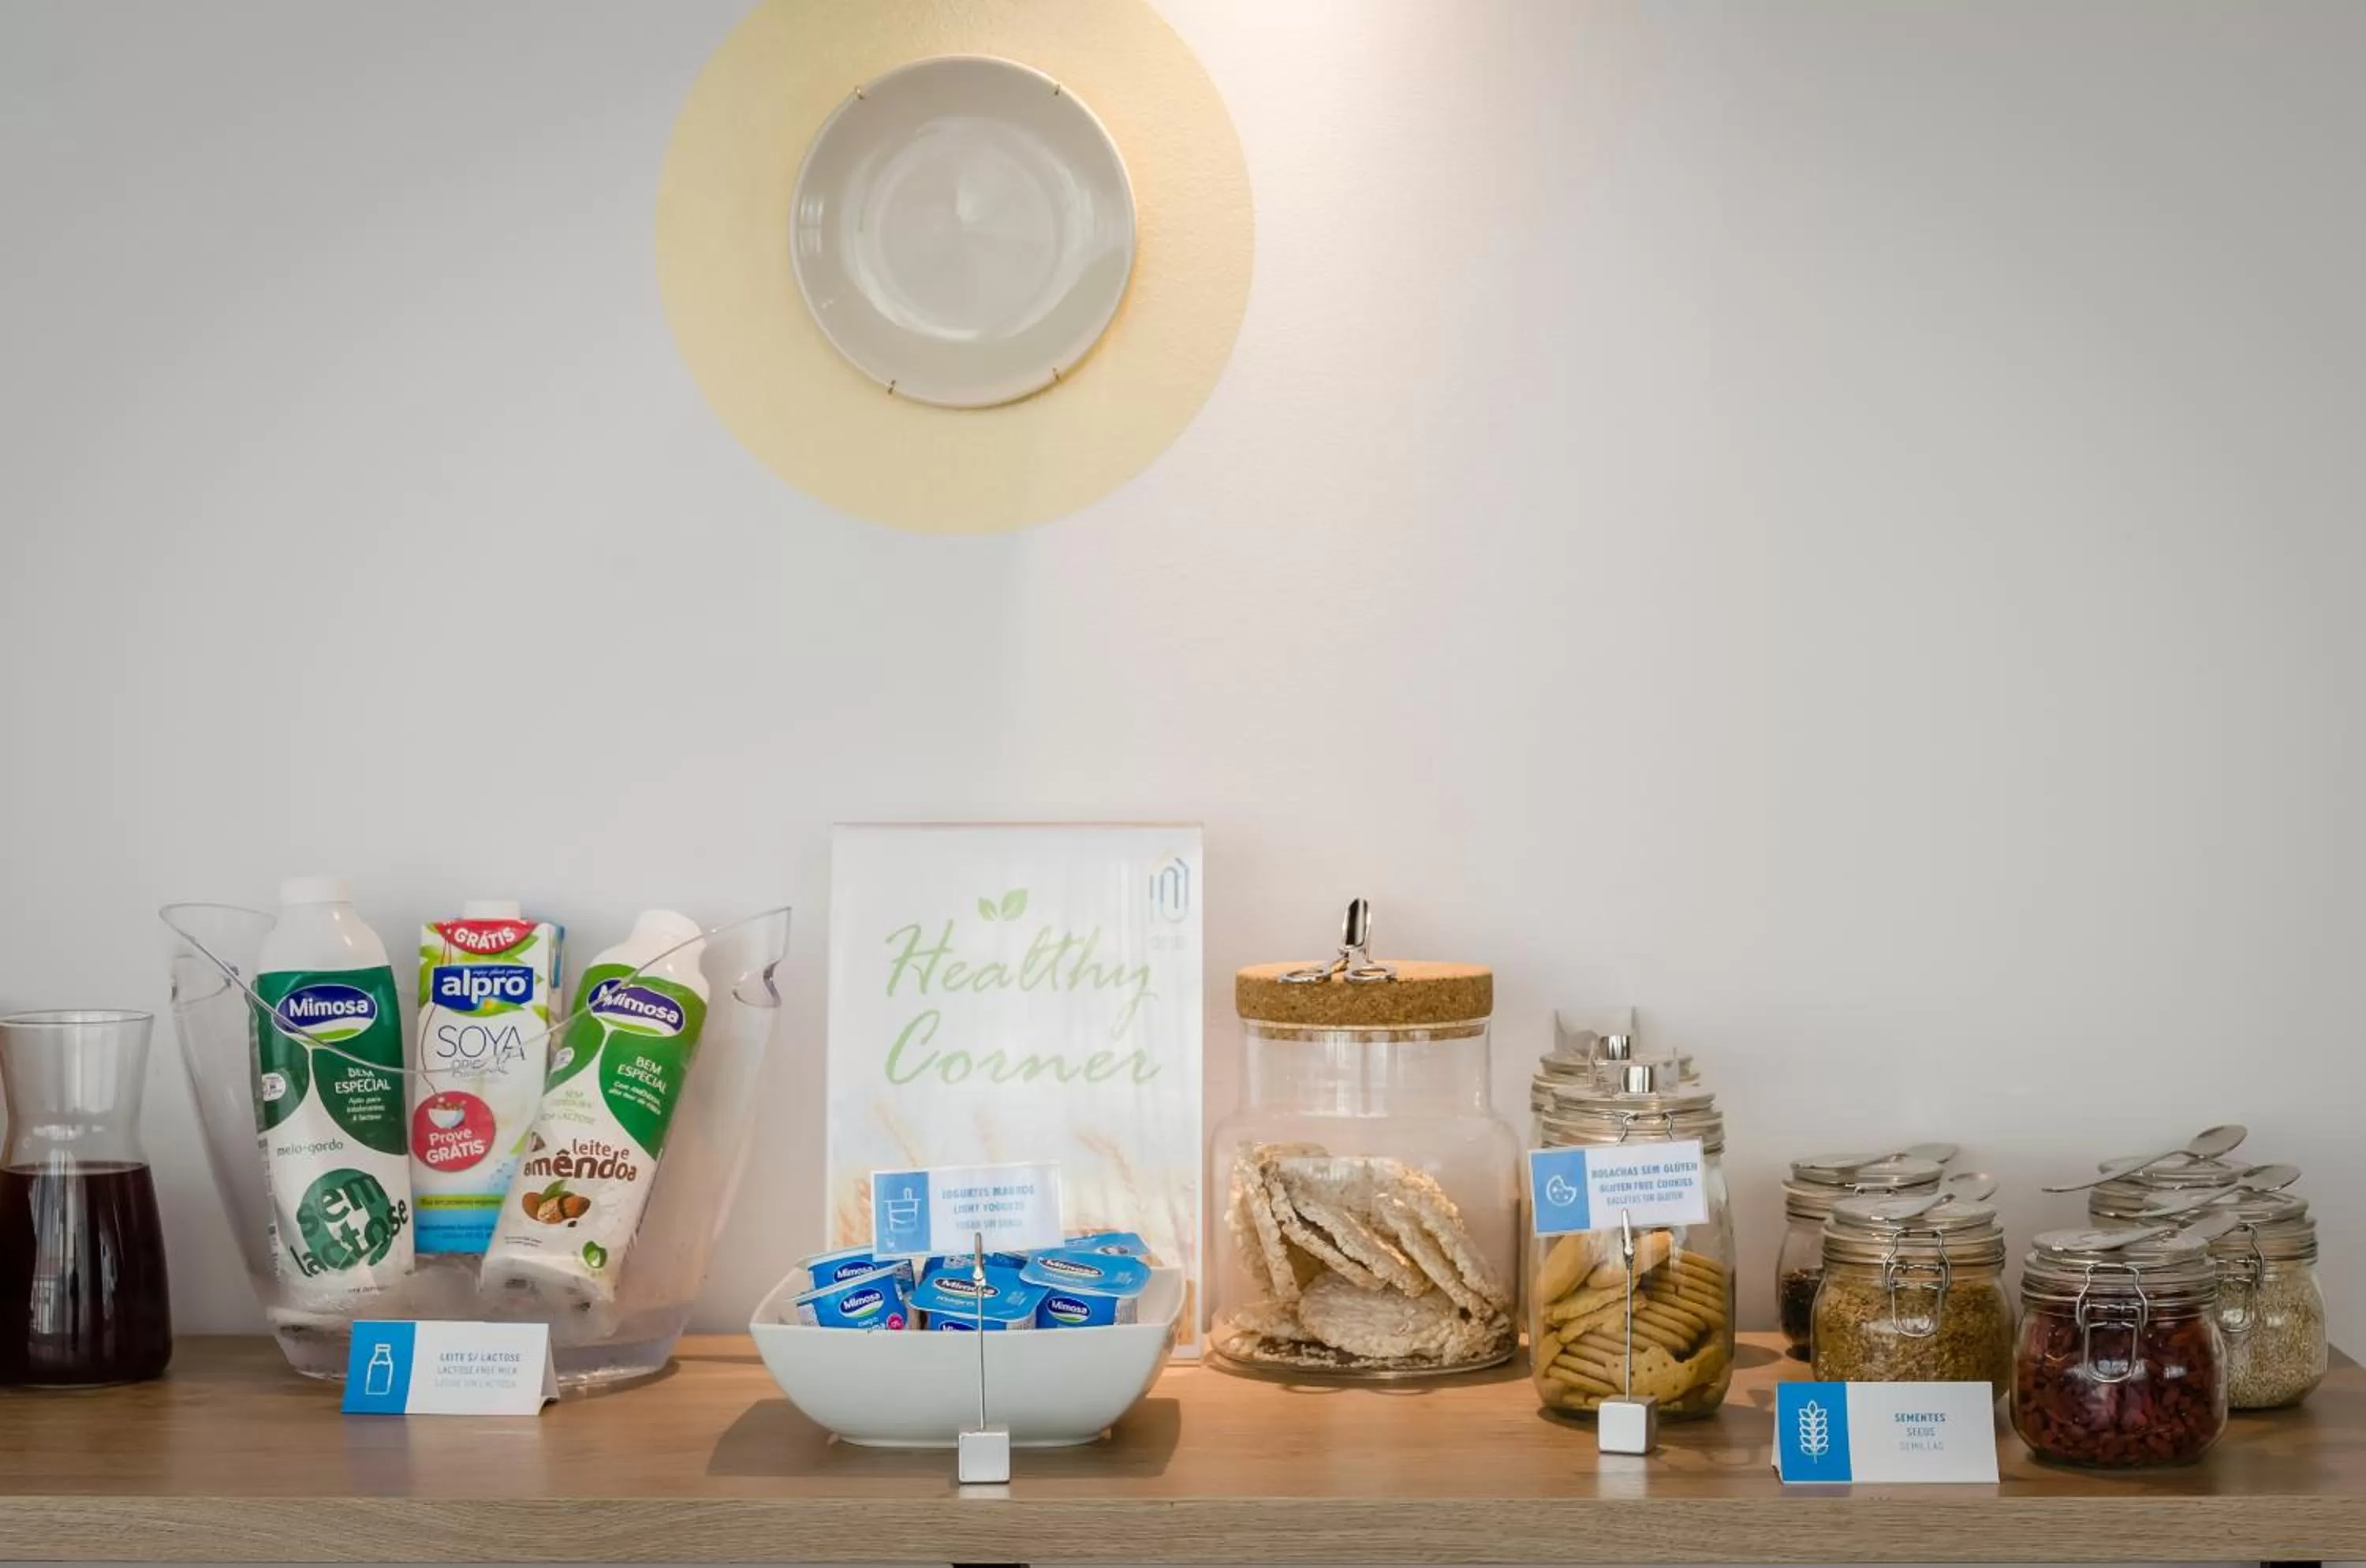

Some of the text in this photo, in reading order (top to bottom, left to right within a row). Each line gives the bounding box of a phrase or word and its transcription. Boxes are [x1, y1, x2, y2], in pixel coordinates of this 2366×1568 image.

[454, 926, 516, 950] GRÁTIS
[441, 969, 526, 1004] alpro
[885, 919, 1159, 1040] Healthy
[289, 997, 368, 1017] Mimosa
[598, 984, 679, 1024] Mimosa
[437, 1025, 525, 1061] SOYA
[885, 1009, 1161, 1086] Corner
[636, 1056, 662, 1074] BEM
[334, 1077, 392, 1094] ESPECIAL
[618, 1065, 667, 1095] ESPECIAL
[429, 1129, 472, 1146] Prove
[573, 1138, 630, 1159] leite e
[426, 1139, 485, 1163] GRÁTIS
[524, 1149, 637, 1182] amêndoa
[1641, 1164, 1660, 1176] SEM
[297, 1174, 380, 1238] sem
[289, 1200, 409, 1278] lactose
[843, 1292, 881, 1310] Mimosa
[1051, 1300, 1088, 1314] Mimosa
[480, 1353, 521, 1362] LACTOSE
[1894, 1413, 1946, 1423] SEMENTES
